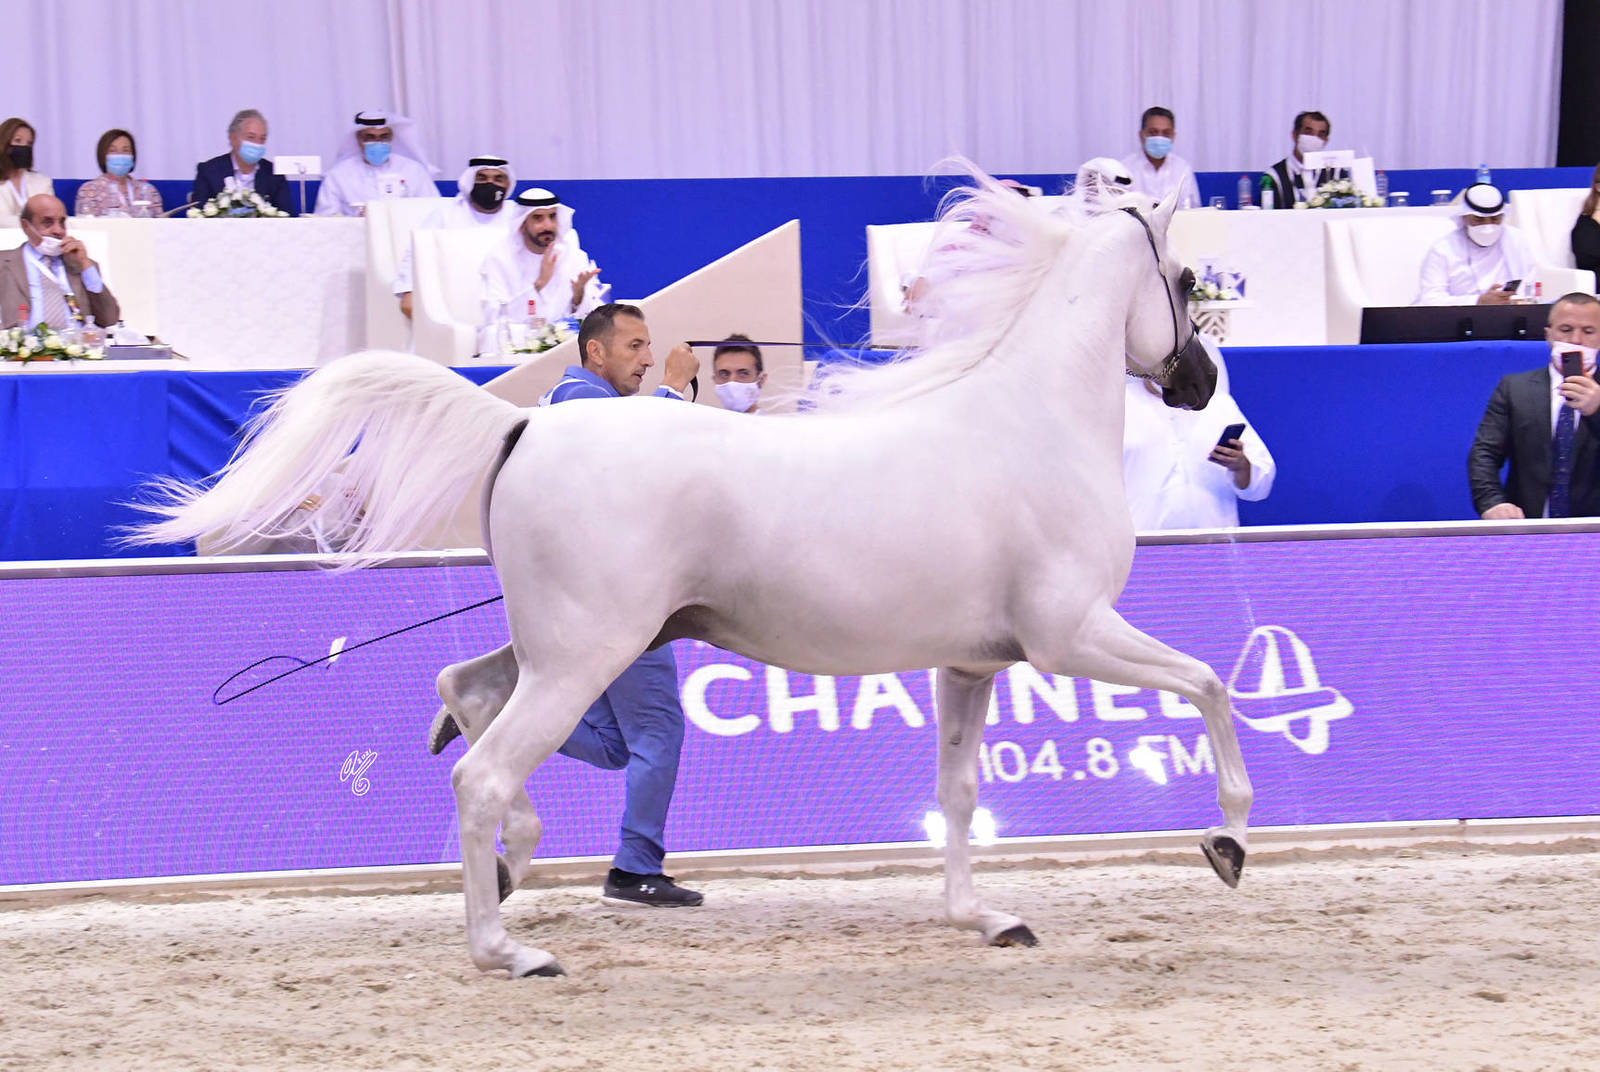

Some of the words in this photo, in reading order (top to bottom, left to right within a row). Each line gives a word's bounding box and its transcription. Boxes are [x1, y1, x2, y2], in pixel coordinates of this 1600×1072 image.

[682, 660, 1203, 737] CHANEL
[978, 738, 1119, 783] 104.8
[1135, 733, 1216, 778] FM
